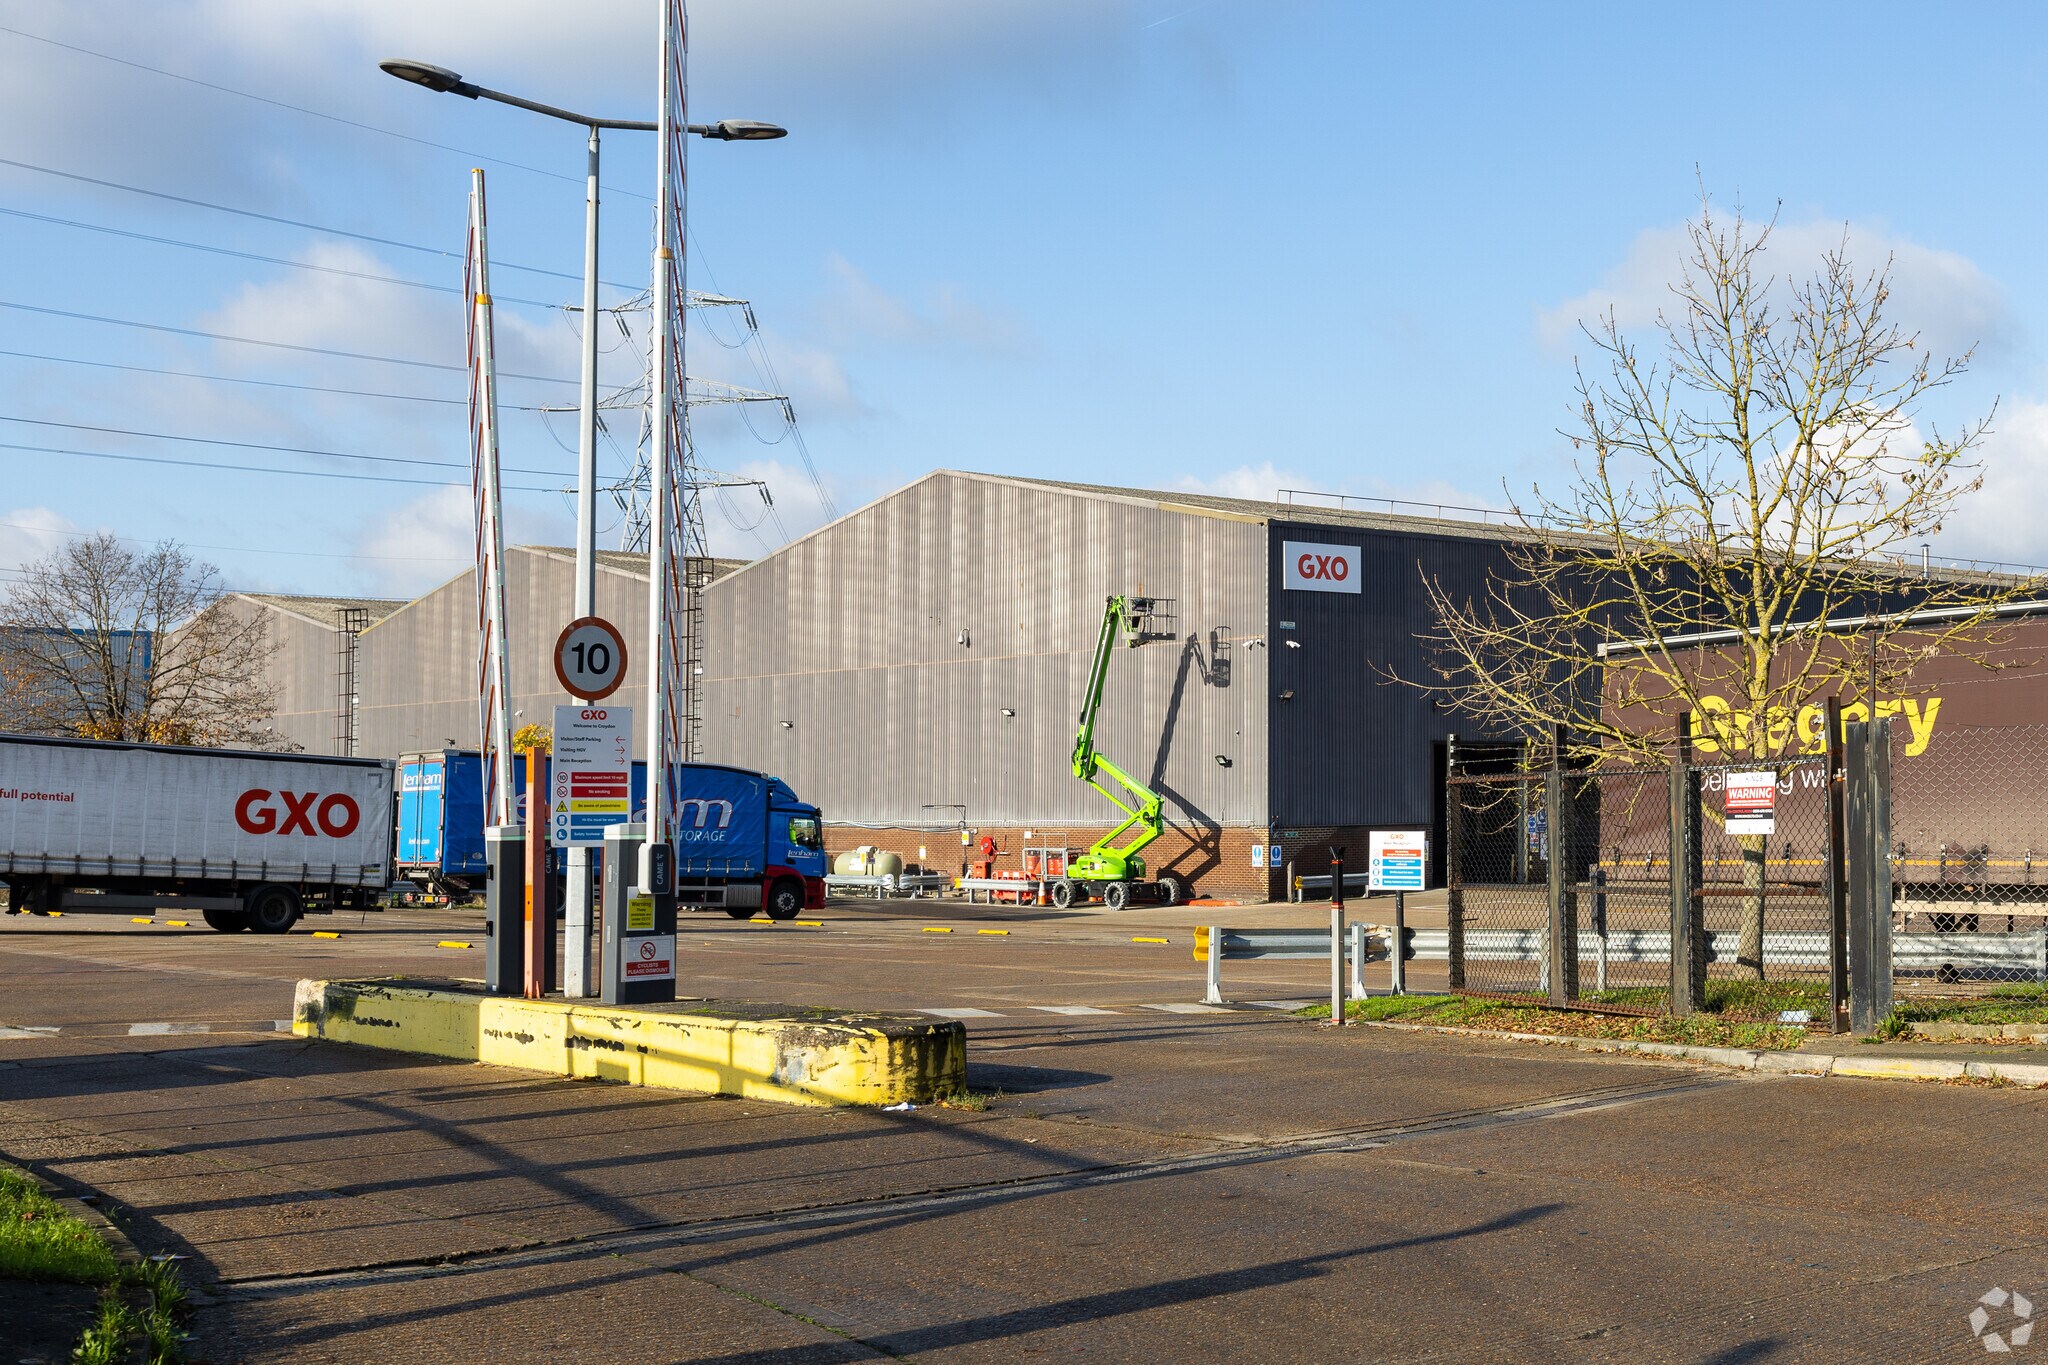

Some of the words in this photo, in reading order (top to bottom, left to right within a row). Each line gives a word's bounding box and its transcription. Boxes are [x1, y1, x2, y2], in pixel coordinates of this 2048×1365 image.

[1298, 553, 1348, 581] GXO
[571, 642, 610, 675] 10
[581, 709, 607, 720] GXO
[21, 791, 75, 802] potential
[1728, 787, 1772, 799] WARNING
[234, 788, 361, 838] GXO
[679, 830, 726, 842] TORAGE
[656, 862, 664, 885] CAME
